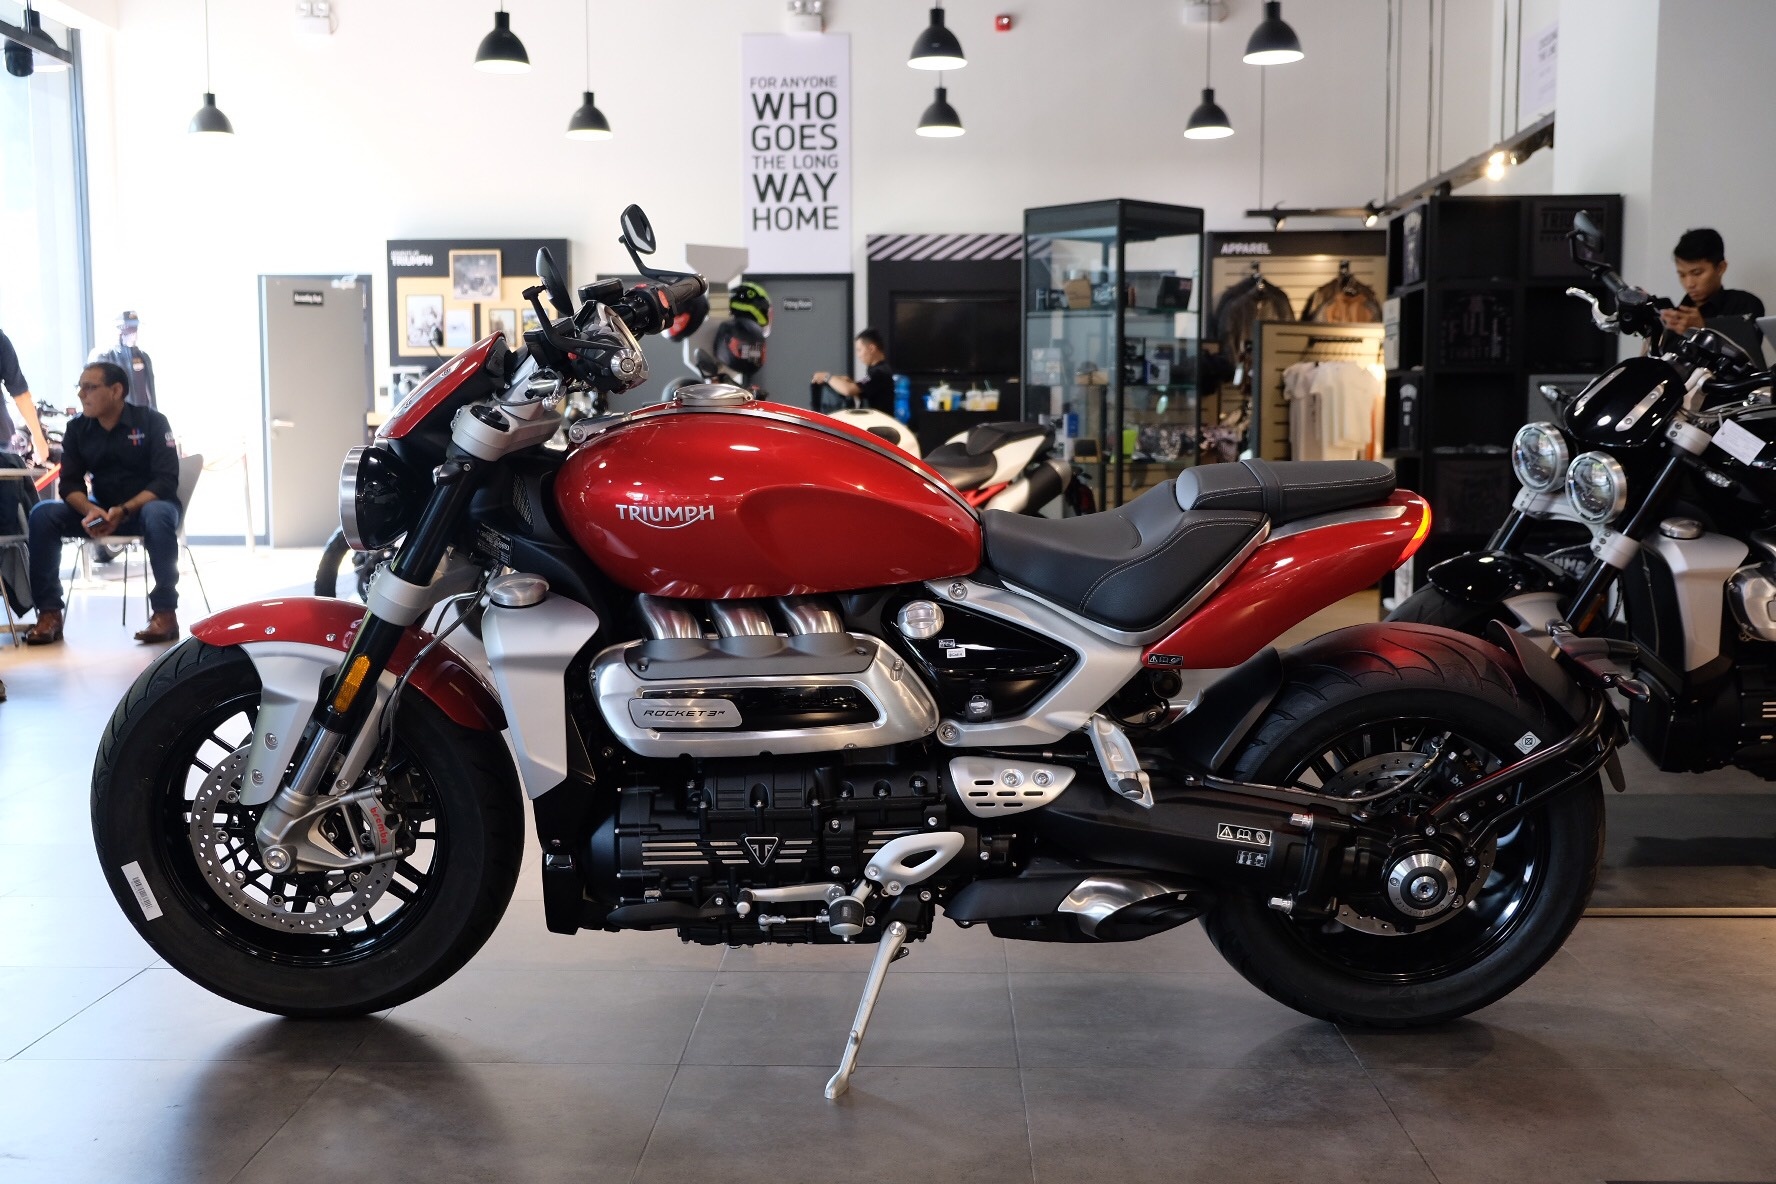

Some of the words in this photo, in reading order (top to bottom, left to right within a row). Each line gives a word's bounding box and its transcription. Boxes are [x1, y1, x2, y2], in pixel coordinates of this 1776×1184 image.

[750, 76, 777, 88] FOR
[780, 75, 838, 88] ANYONE
[752, 91, 838, 121] WHO
[752, 123, 838, 151] GOES
[752, 155, 786, 170] THE
[793, 154, 839, 170] LONG
[752, 172, 838, 203] WAY
[753, 206, 839, 231] HOME
[391, 254, 434, 267] TRIUMPH
[1220, 242, 1271, 255] APPAREL
[615, 504, 715, 529] TRIUMPH
[370, 806, 388, 845] brembo
